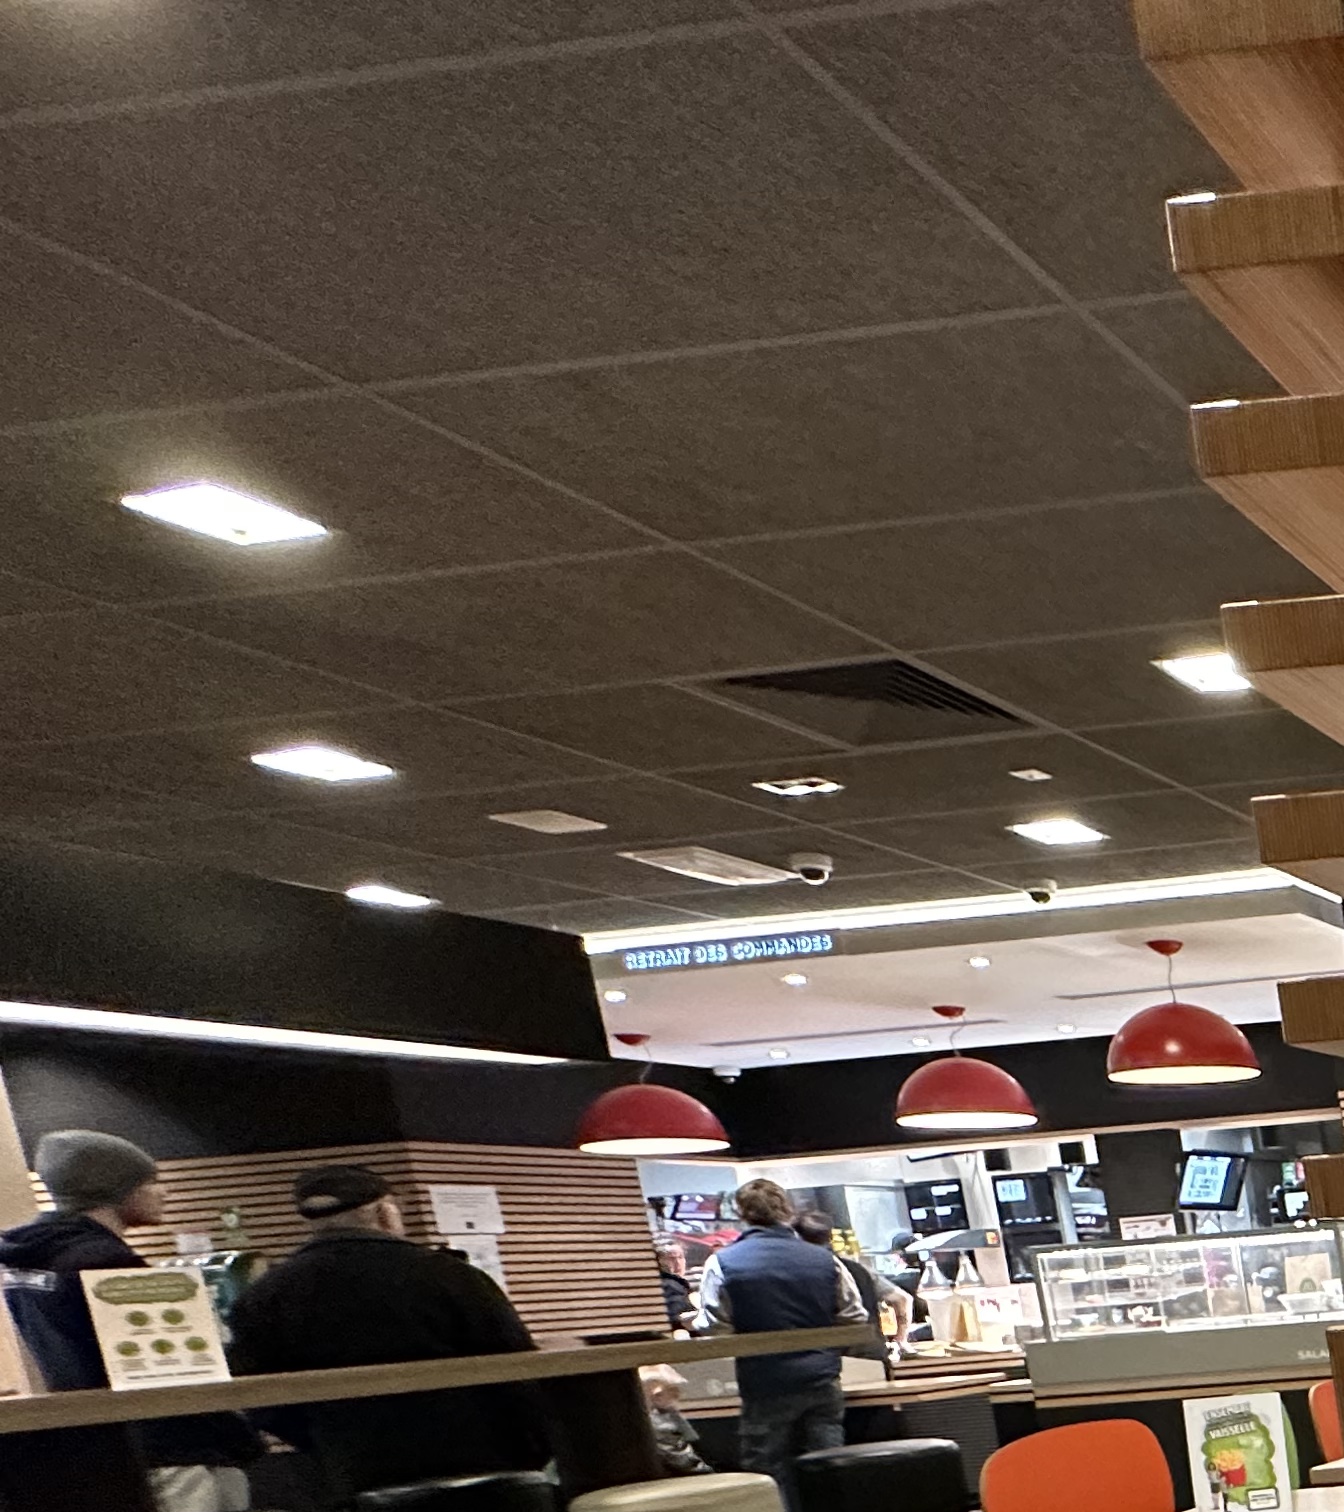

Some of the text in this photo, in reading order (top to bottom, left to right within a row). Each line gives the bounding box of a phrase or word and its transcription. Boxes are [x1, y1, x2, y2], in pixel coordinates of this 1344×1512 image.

[624, 934, 834, 970] RETRAIT DES COMMANDES
